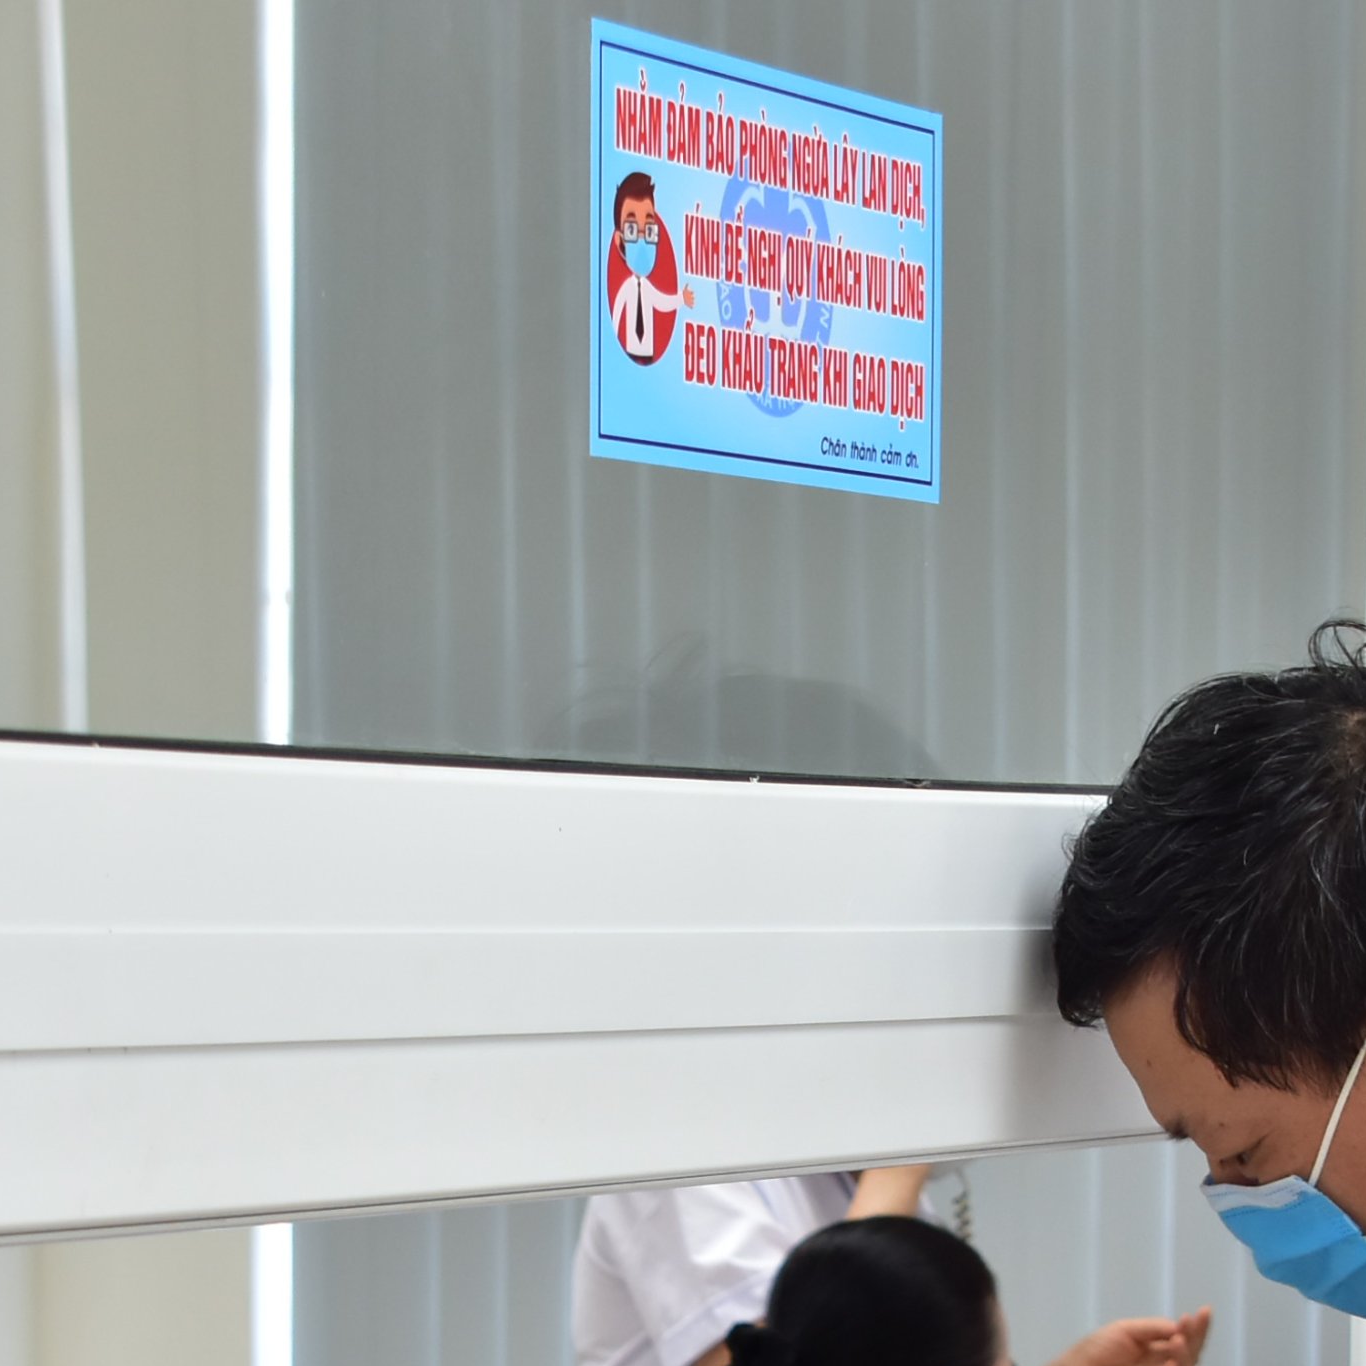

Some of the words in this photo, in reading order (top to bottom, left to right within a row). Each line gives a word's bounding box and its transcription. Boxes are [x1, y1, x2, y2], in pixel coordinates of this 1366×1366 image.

[616, 69, 662, 159] NHẰM
[667, 82, 701, 169] ĐẢM
[706, 93, 735, 177] BẢO
[739, 110, 787, 189] PHÒNG
[792, 126, 829, 200] NGỪA
[834, 134, 858, 206] LÂY
[862, 151, 887, 213] LAN
[891, 159, 925, 230] DỊCH,
[684, 203, 720, 280] KÍNH
[724, 205, 743, 283] ĐỀ
[748, 228, 781, 306] NGHỊ
[786, 228, 813, 303] QUÝ
[817, 236, 862, 308] KHÁCH
[866, 254, 887, 314] VUI
[891, 247, 925, 321] LÒNG
[684, 322, 716, 386] ĐEO
[721, 309, 764, 393] KHẨU
[769, 338, 818, 403] TRANG
[823, 347, 848, 408] KHI
[853, 353, 886, 414] GIAO
[891, 360, 924, 430] DỊCH
[820, 436, 847, 458] Chân
[850, 440, 877, 462] thành
[880, 443, 902, 465] cảm
